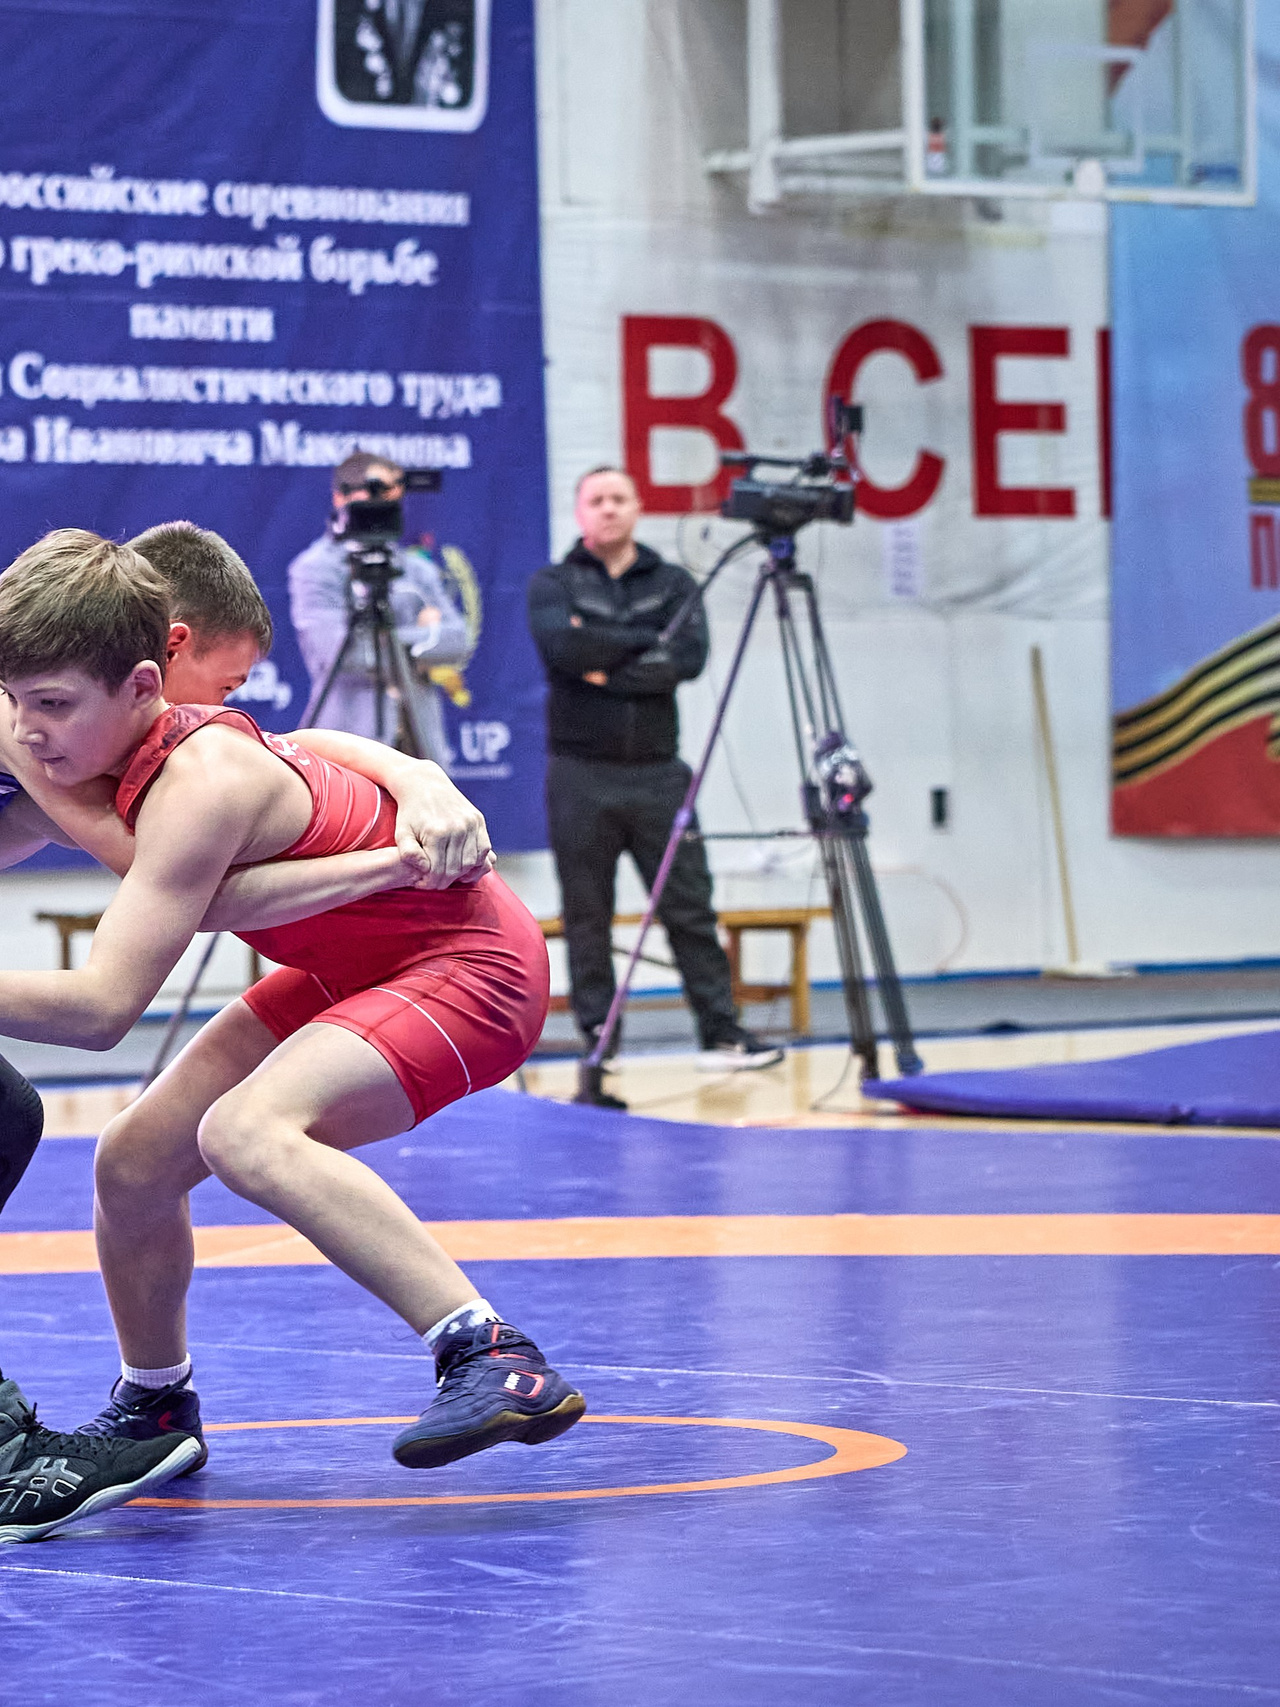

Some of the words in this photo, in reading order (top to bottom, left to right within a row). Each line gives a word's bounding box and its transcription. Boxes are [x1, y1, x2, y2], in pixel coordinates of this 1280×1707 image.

[10, 234, 304, 289] греко-римской
[309, 235, 438, 296] борьбе
[128, 303, 275, 343] памяти
[8, 351, 396, 410] Социалистического
[397, 372, 503, 419] труда
[32, 415, 255, 466] Ивановича
[823, 318, 1112, 520] СЕ
